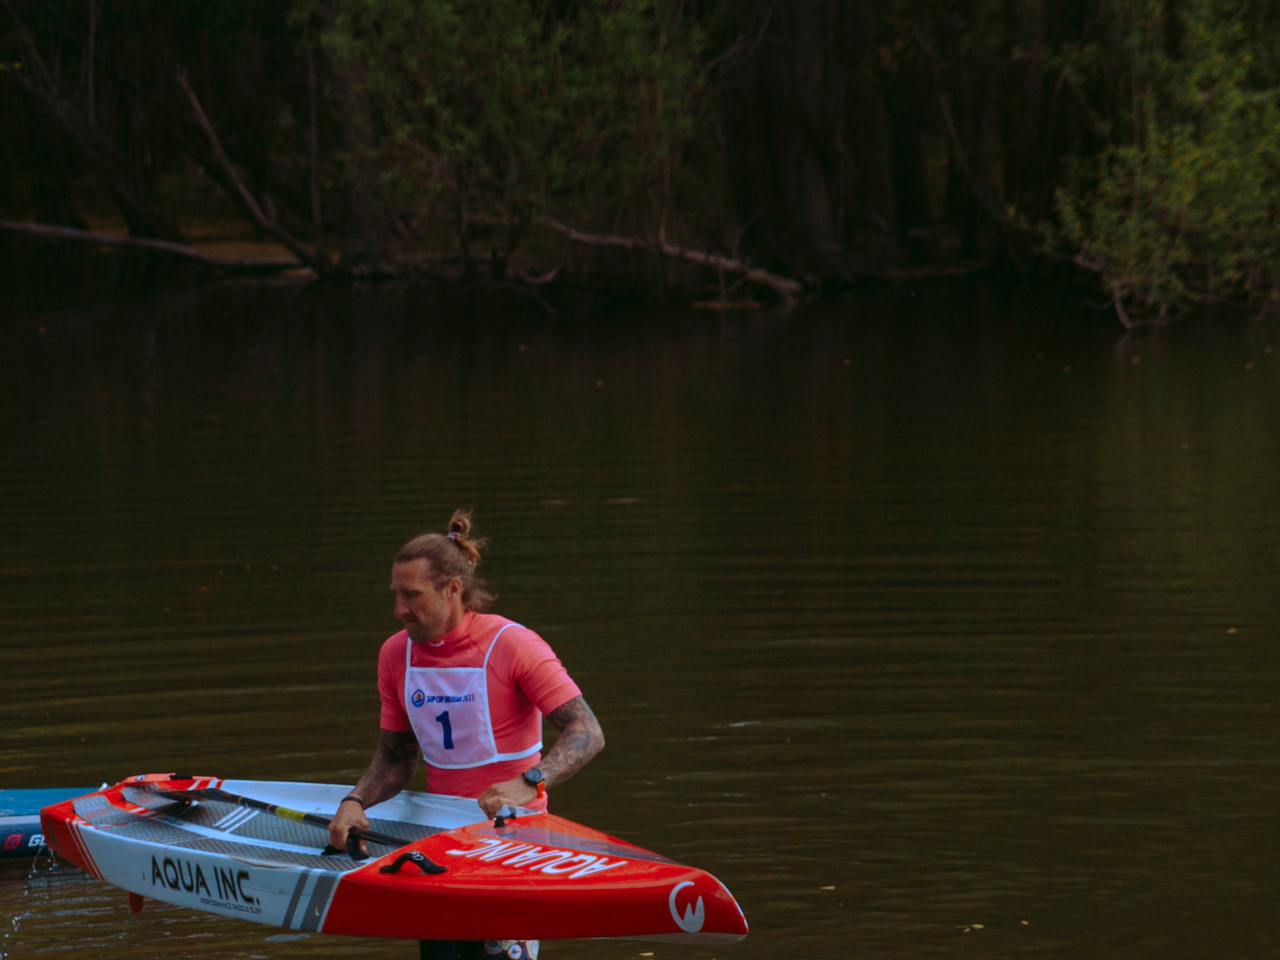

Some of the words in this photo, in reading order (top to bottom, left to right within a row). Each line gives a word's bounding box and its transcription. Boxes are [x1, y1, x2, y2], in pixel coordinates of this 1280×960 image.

[435, 710, 455, 750] 1
[151, 855, 212, 897] AQUA
[213, 865, 261, 905] INC.
[502, 846, 628, 879] AQUA
